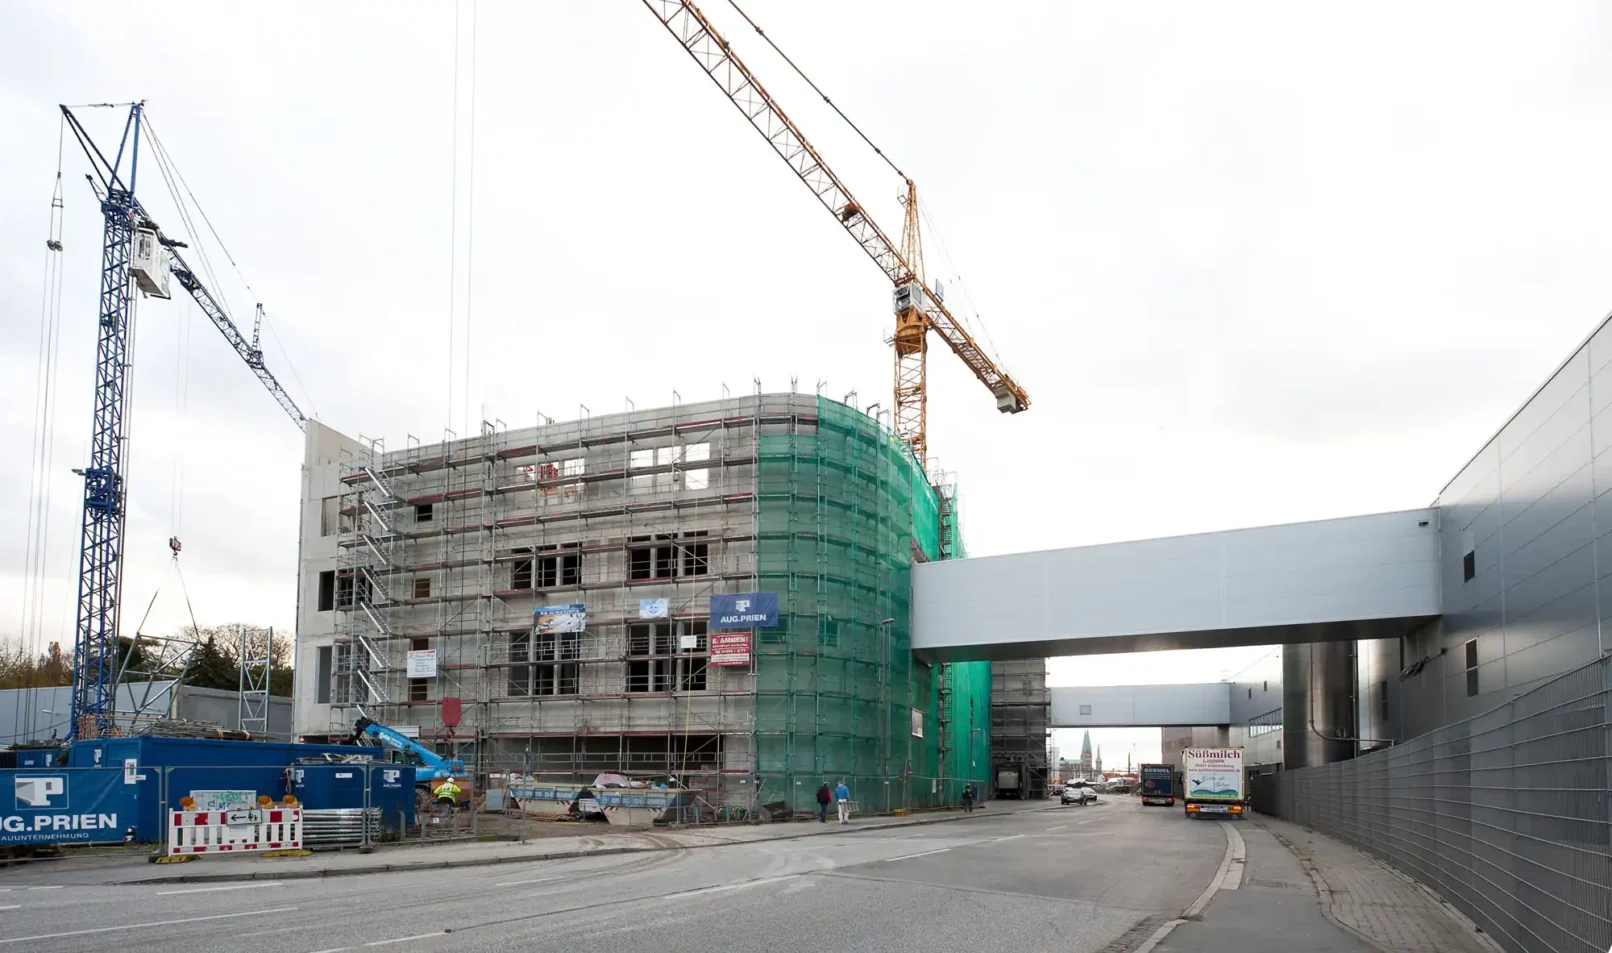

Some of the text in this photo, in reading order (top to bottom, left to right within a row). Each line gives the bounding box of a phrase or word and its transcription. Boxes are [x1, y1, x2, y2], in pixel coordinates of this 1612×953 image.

[720, 613, 767, 623] AUG.PRIEN
[1188, 750, 1240, 759] Süßmilch
[0, 813, 117, 832] G.PRIEN
